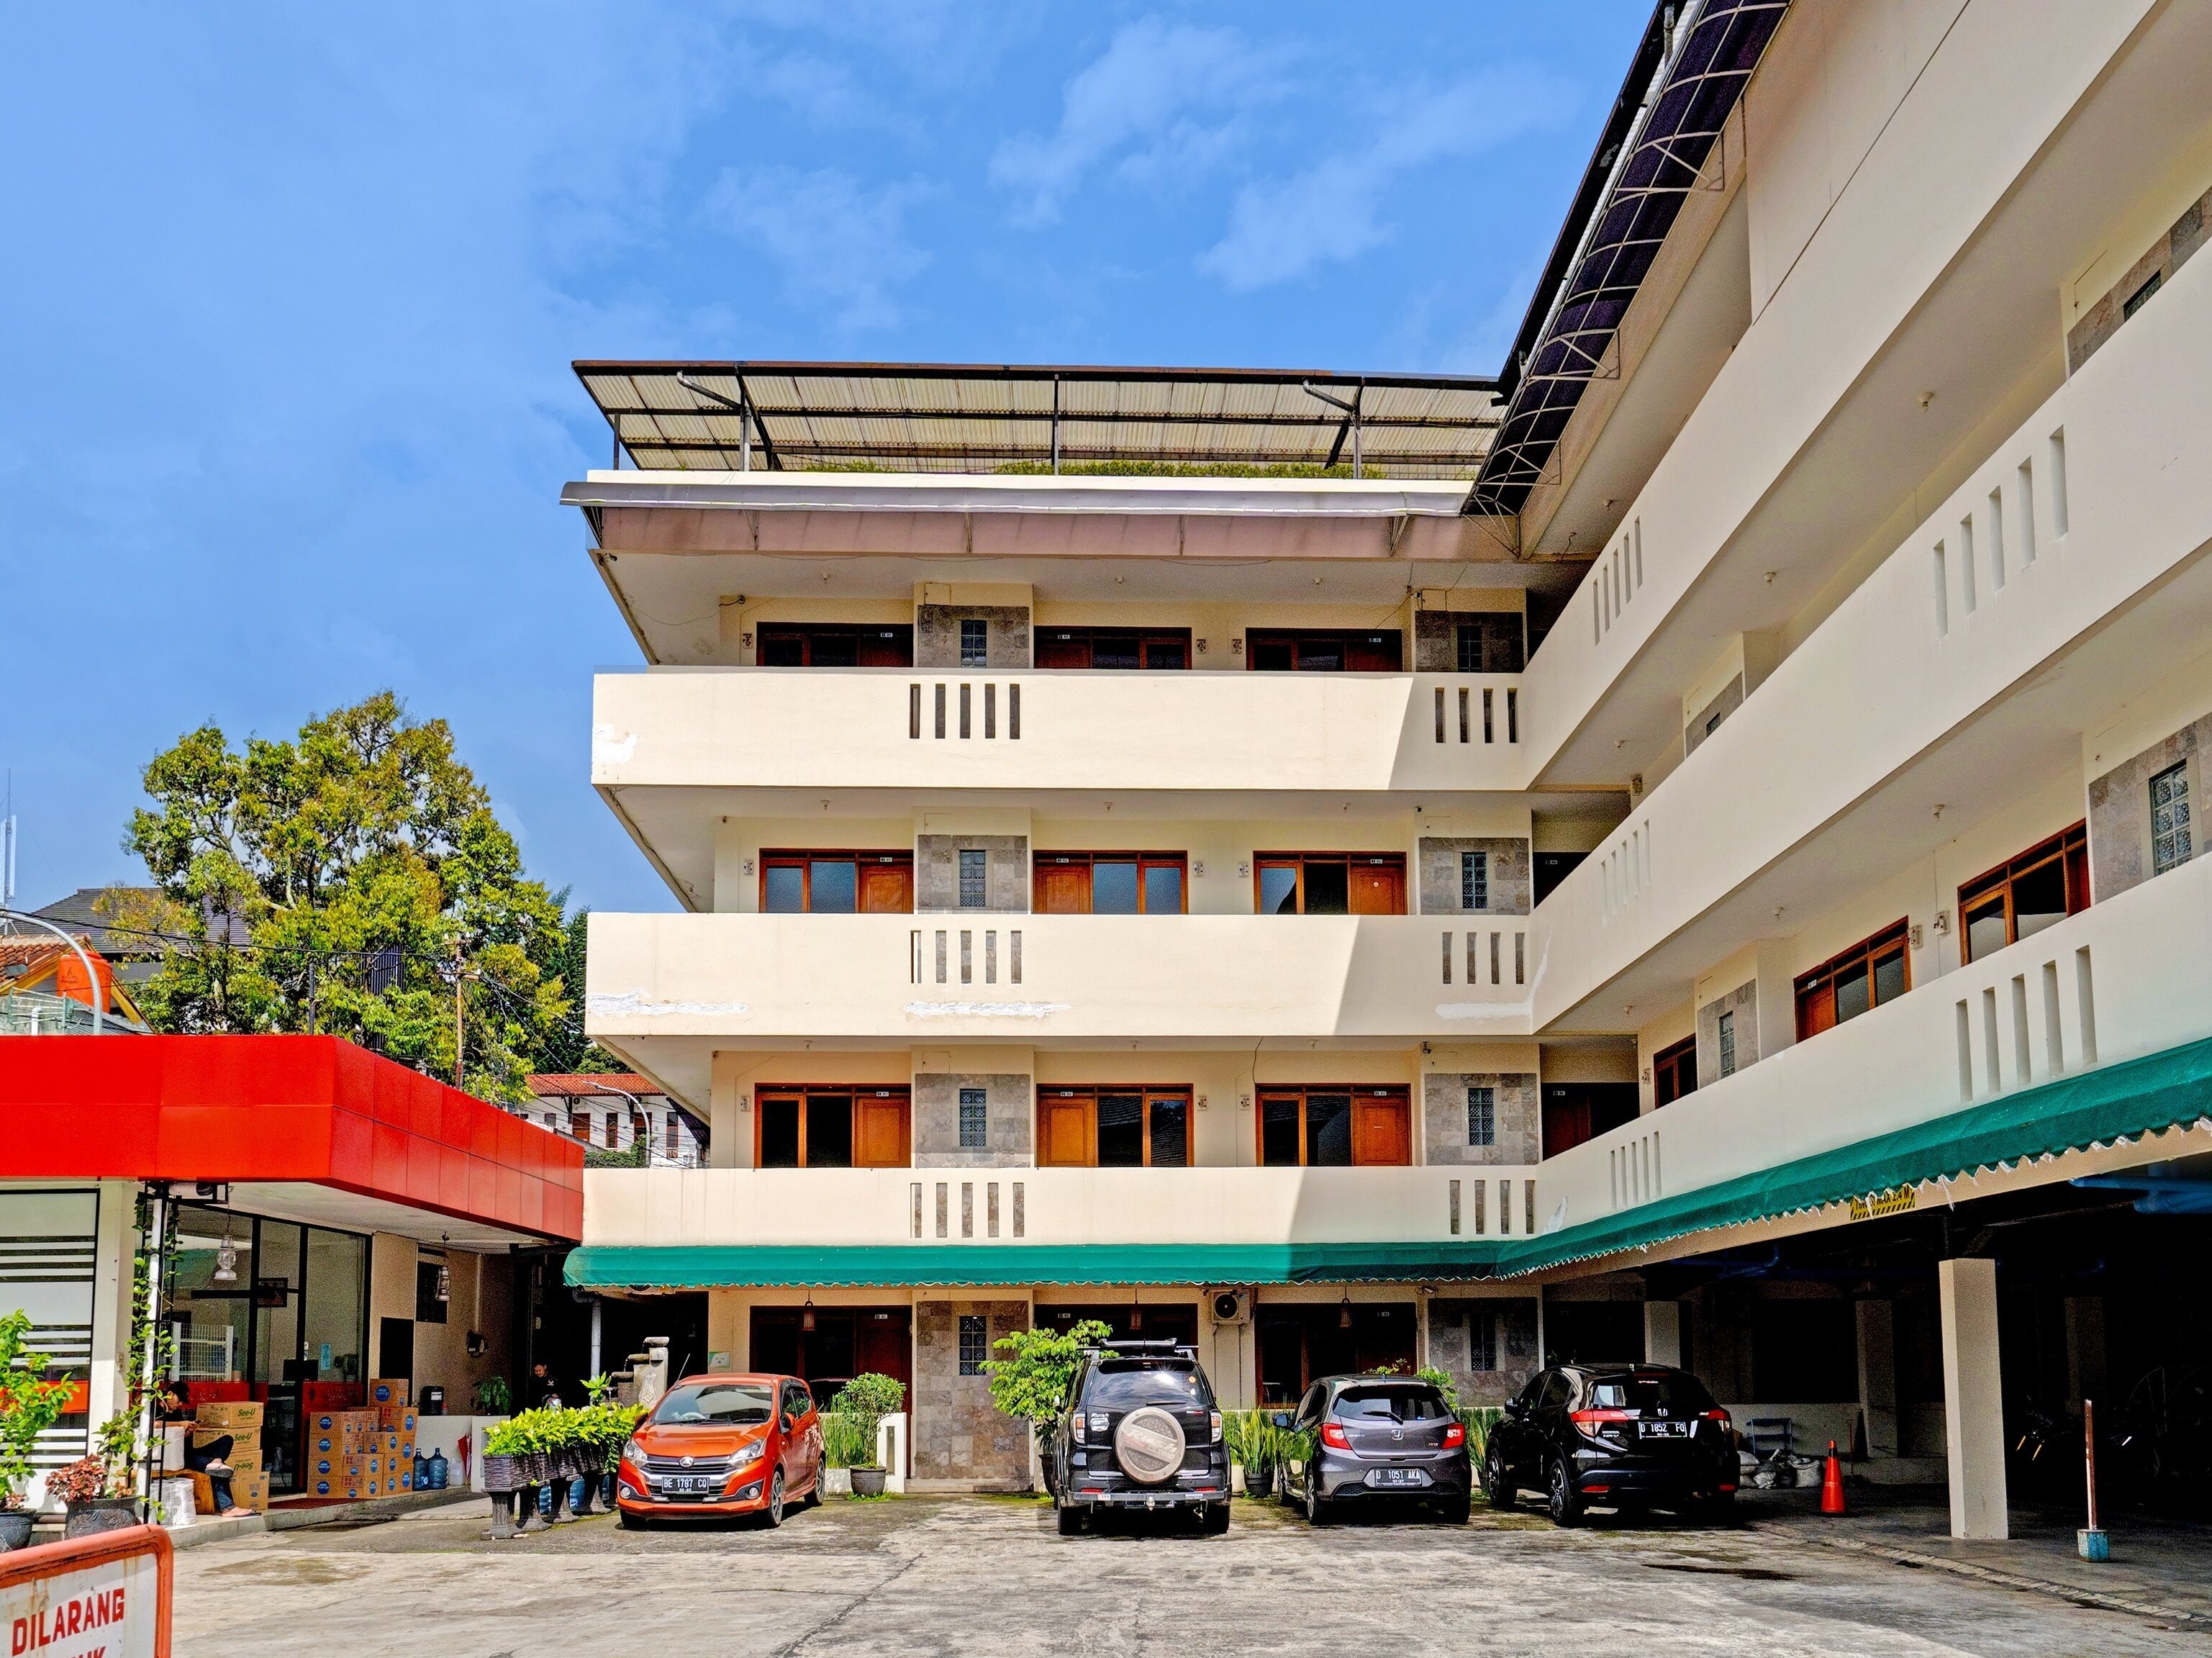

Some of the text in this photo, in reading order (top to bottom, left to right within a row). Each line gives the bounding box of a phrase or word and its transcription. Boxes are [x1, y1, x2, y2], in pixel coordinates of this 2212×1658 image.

[237, 1408, 255, 1417] See-U
[1640, 1423, 1646, 1433] D
[1651, 1423, 1667, 1433] 1852
[1375, 1470, 1420, 1480] D 1051 AKA
[663, 1479, 673, 1488] BE
[677, 1479, 694, 1488] 1787
[12, 1587, 124, 1657] DILARANG
